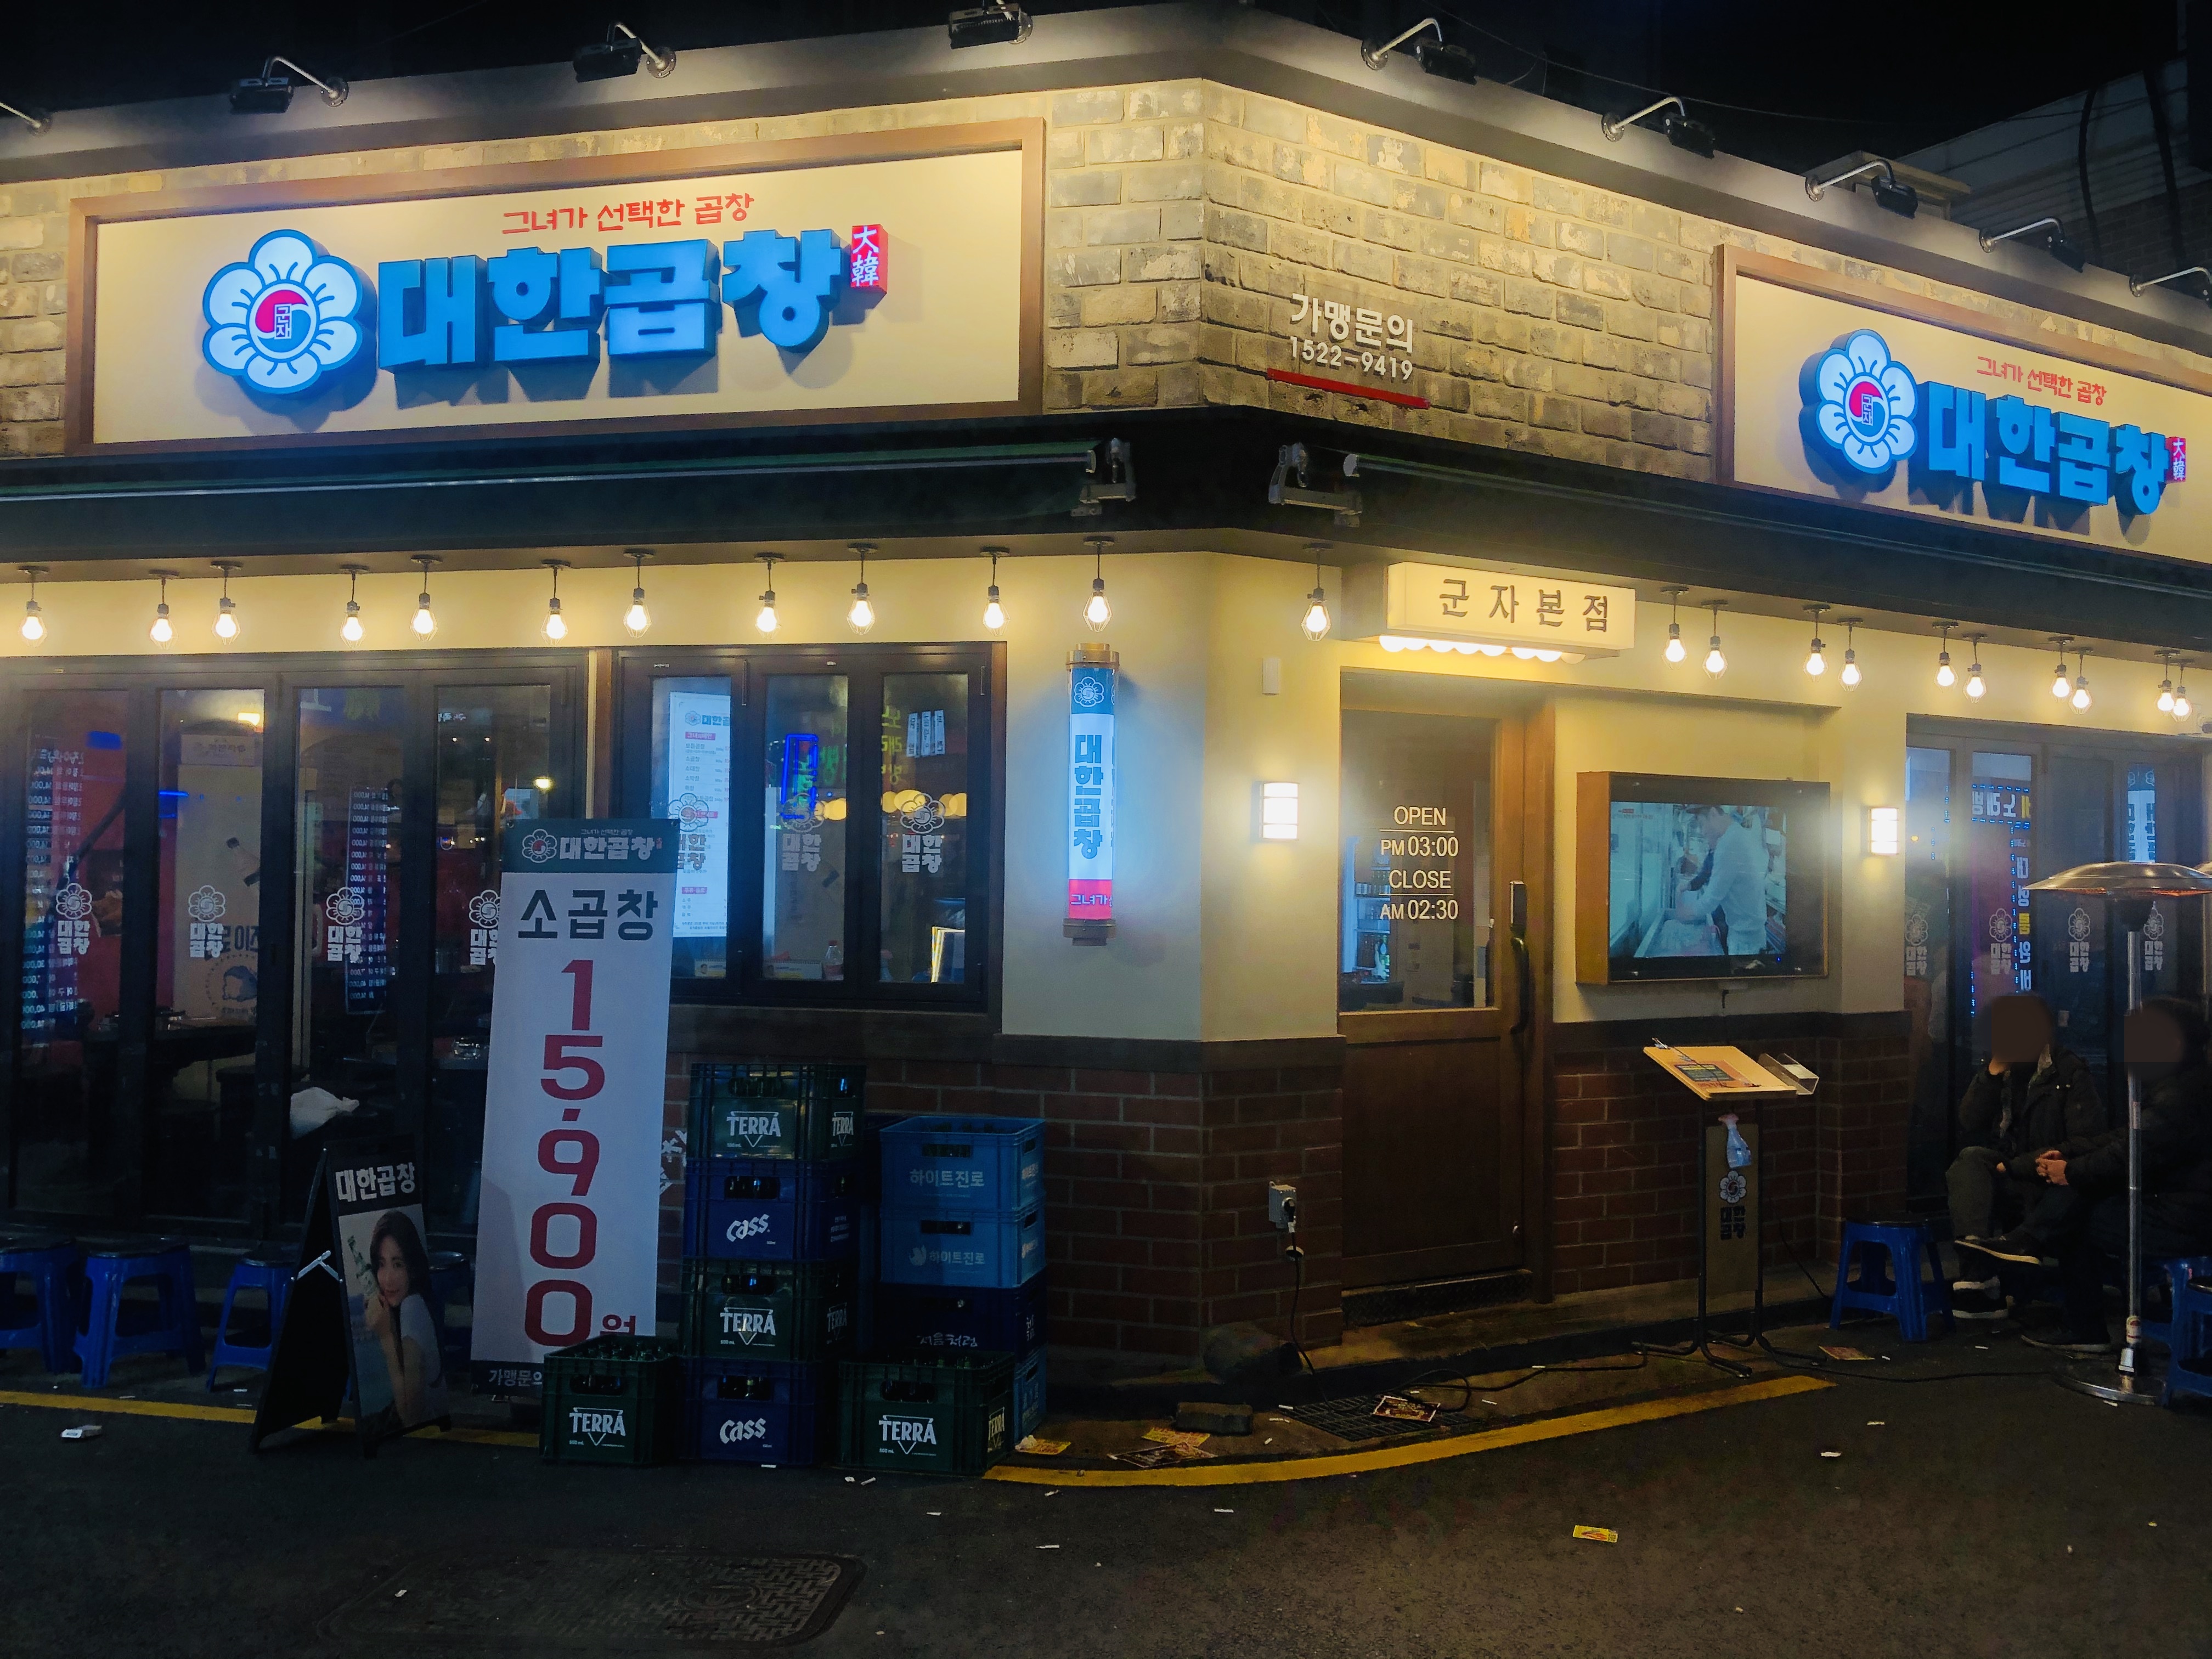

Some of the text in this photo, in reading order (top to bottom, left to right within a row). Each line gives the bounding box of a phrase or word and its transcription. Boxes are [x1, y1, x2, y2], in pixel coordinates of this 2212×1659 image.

[502, 193, 754, 234] 그녀가 선택한 곱창
[853, 225, 881, 286] 大韓
[378, 229, 840, 371] 대한곱창
[1291, 293, 1413, 353] 가맹문의
[1291, 336, 1413, 380] 1522-9419
[1977, 356, 2107, 406] 그녀가 선택한 곱창
[1926, 381, 2169, 515] 대한곱창
[2172, 437, 2186, 481] 大韓
[1074, 734, 1104, 859] 대한곱창
[1394, 806, 1446, 826] OPEN
[560, 837, 655, 861] 대한곱창
[783, 833, 822, 852] 대한
[902, 834, 944, 853] 대한
[1380, 836, 1459, 857] PM 03:00
[782, 853, 821, 872] 곱창
[901, 853, 942, 873] 곱창
[1389, 870, 1451, 889] CLOSE
[1070, 894, 1107, 905] 그녀가
[1380, 900, 1459, 920] AM 02:30
[518, 889, 658, 941] 소곱창
[58, 920, 90, 938] 대한
[190, 922, 224, 940] 대한
[328, 926, 363, 944] 대한
[57, 938, 90, 956] 곱창
[190, 940, 224, 958] 곱창
[328, 944, 362, 962] 곱창
[726, 1116, 781, 1137] TERRA
[832, 1116, 854, 1136] TERRA
[336, 1161, 416, 1203] 대한곱창
[910, 1169, 985, 1188] 하이트진로
[929, 1251, 986, 1265] 하이트진로
[720, 1312, 776, 1336] TERRA
[827, 1307, 847, 1333] TERRA
[569, 1412, 626, 1436] TERRA
[878, 1420, 937, 1445] TERRA
